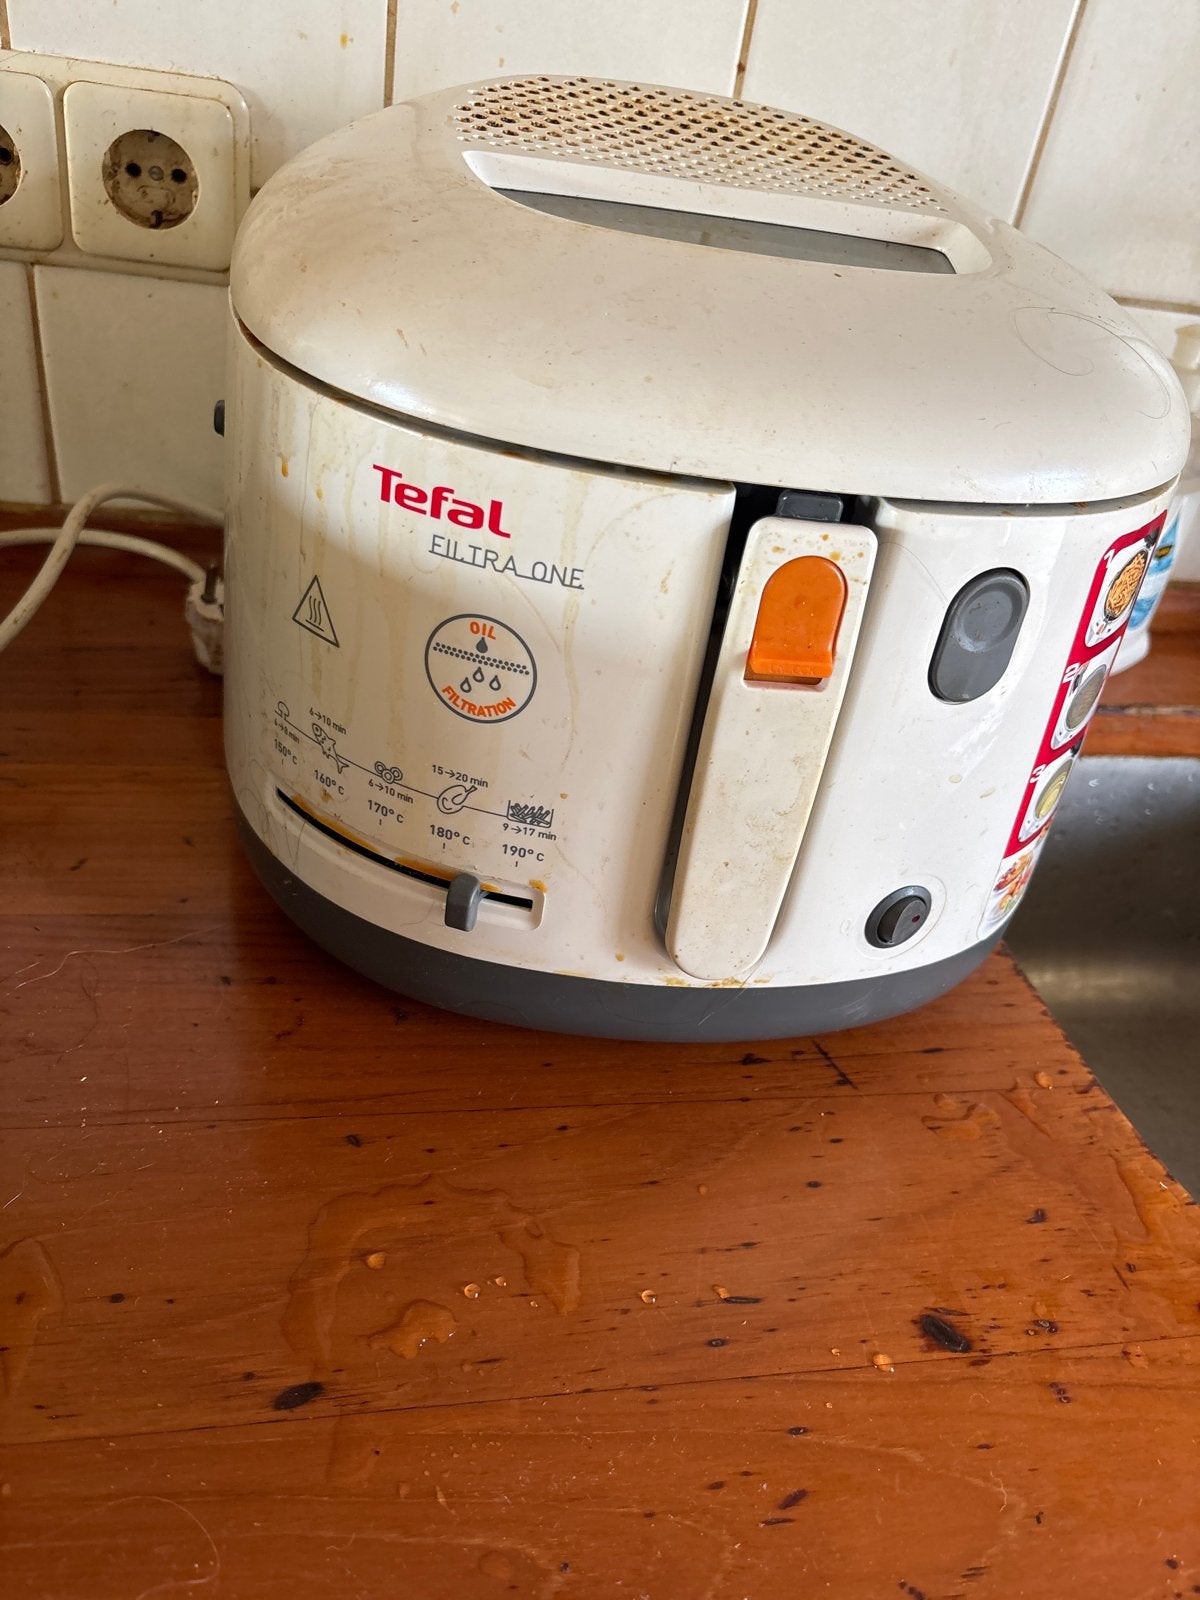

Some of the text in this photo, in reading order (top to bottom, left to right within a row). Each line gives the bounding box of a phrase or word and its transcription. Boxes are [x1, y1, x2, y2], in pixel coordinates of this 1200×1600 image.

[372, 463, 511, 539] Tefal
[428, 534, 585, 590] FILTRA ONE
[469, 621, 497, 640] OIL
[1062, 663, 1080, 684] 2
[441, 684, 517, 718] FILTRATION
[332, 721, 347, 735] min
[469, 776, 489, 788] min
[396, 790, 414, 804] min
[537, 831, 557, 841] min
